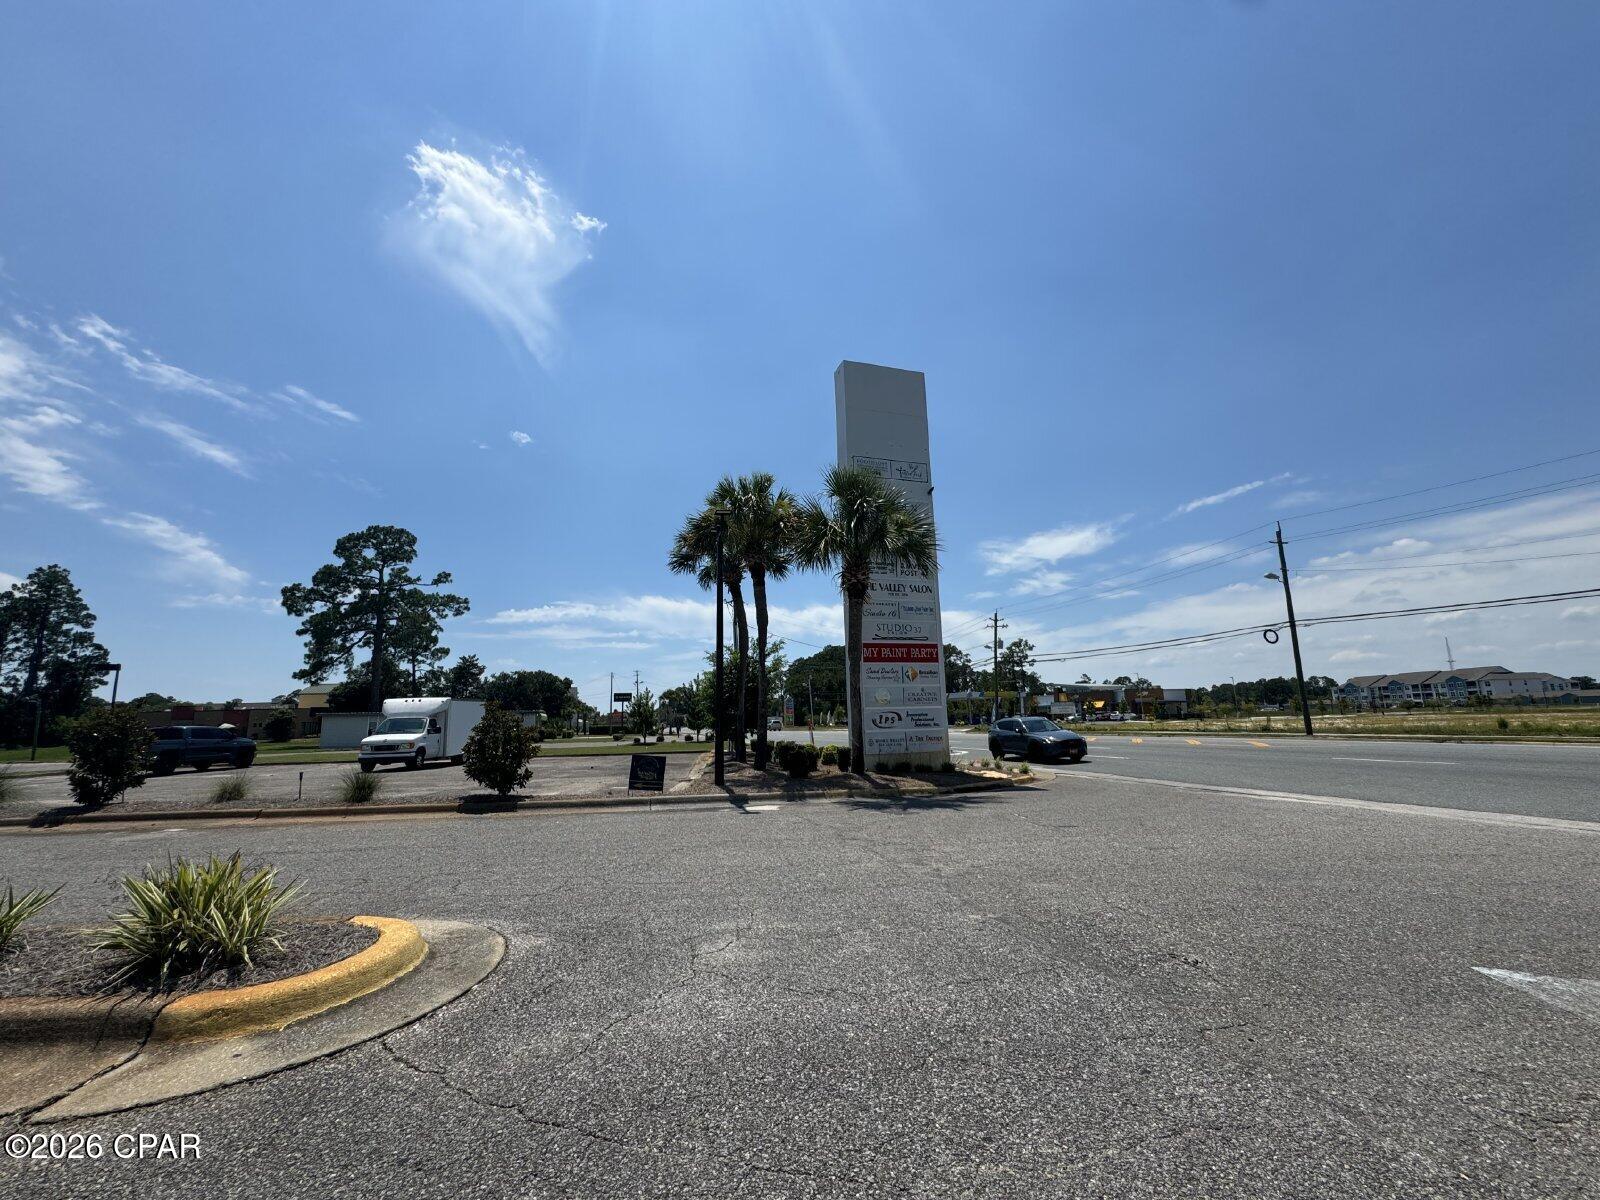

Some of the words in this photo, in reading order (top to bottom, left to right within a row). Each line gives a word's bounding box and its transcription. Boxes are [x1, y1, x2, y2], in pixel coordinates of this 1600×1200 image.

[879, 583, 907, 592] VALLEY
[909, 584, 933, 594] SALON
[876, 623, 913, 632] STUDIO
[863, 647, 880, 658] MY
[881, 647, 908, 658] PAINT
[910, 647, 938, 658] PARTY
[878, 714, 896, 724] IPS
